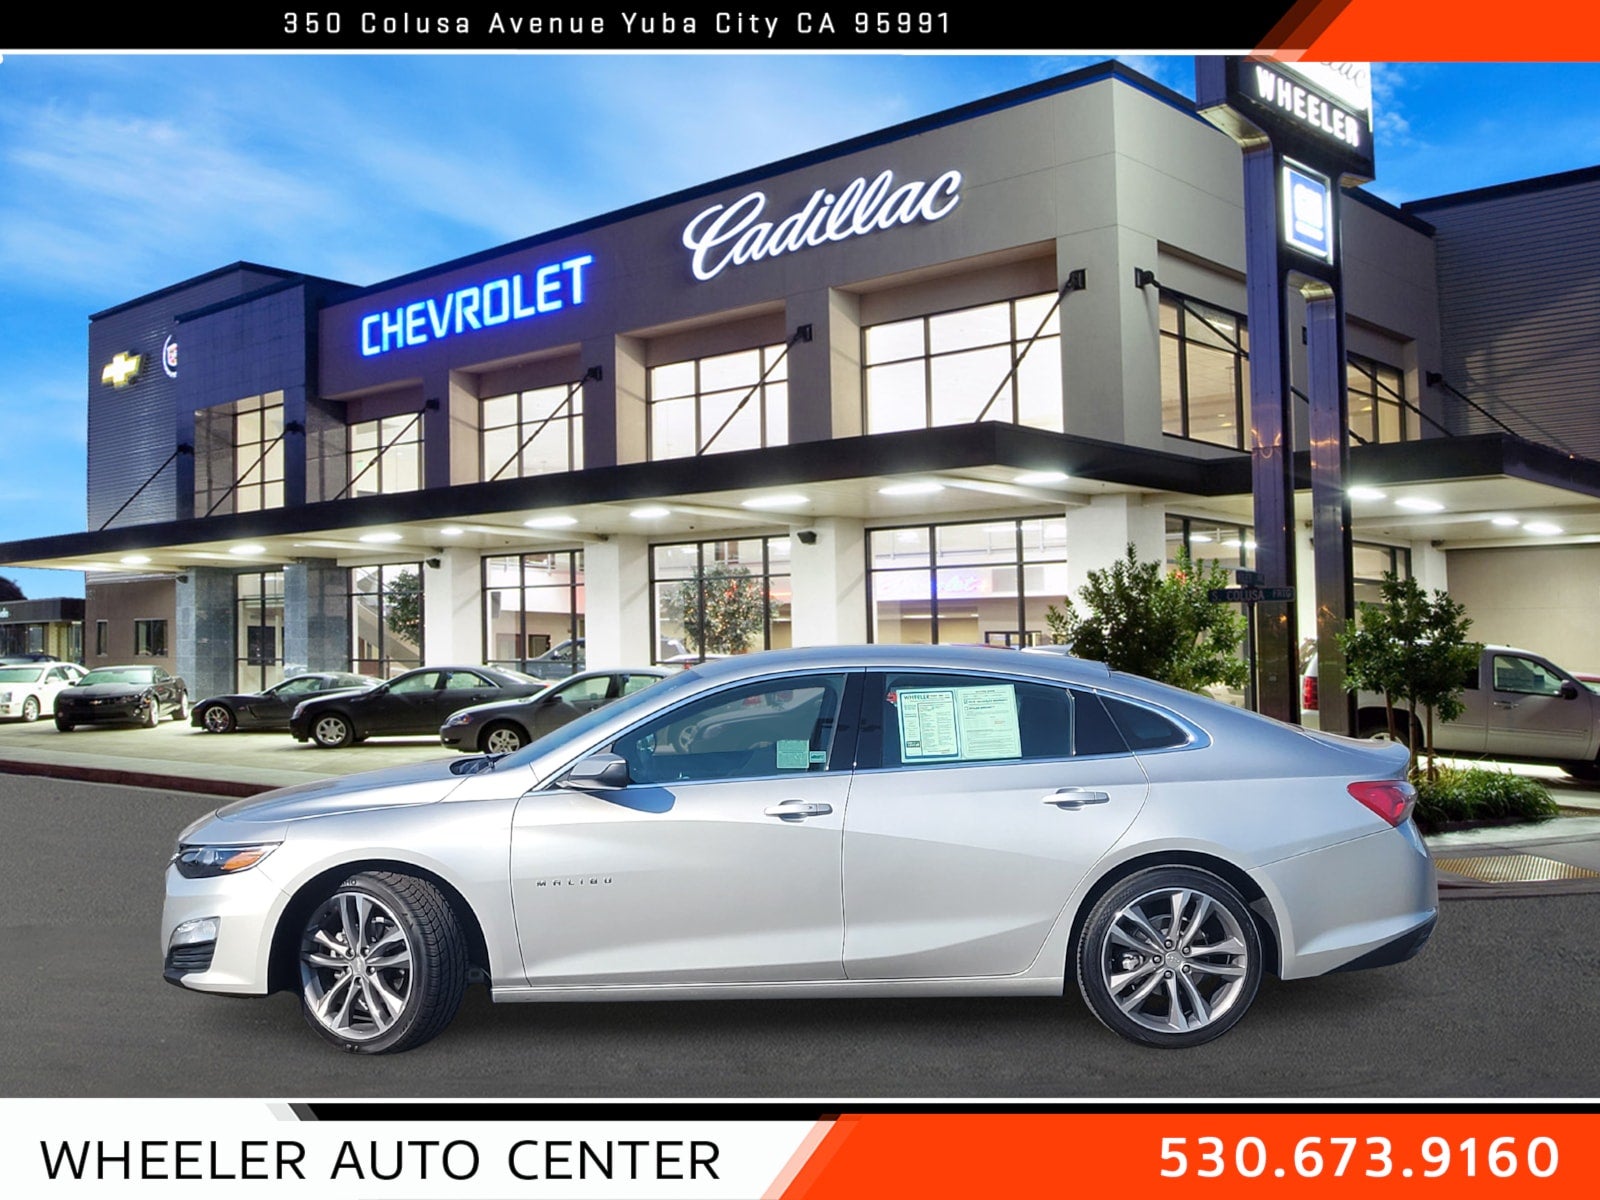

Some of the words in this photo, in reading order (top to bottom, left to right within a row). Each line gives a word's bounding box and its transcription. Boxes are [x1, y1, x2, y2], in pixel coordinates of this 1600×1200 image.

[1255, 65, 1360, 148] WHEELER
[682, 170, 963, 281] Cadillac
[361, 255, 593, 357] CHEVROLET
[1226, 589, 1265, 600] COLUSA
[536, 877, 612, 887] MALIBU
